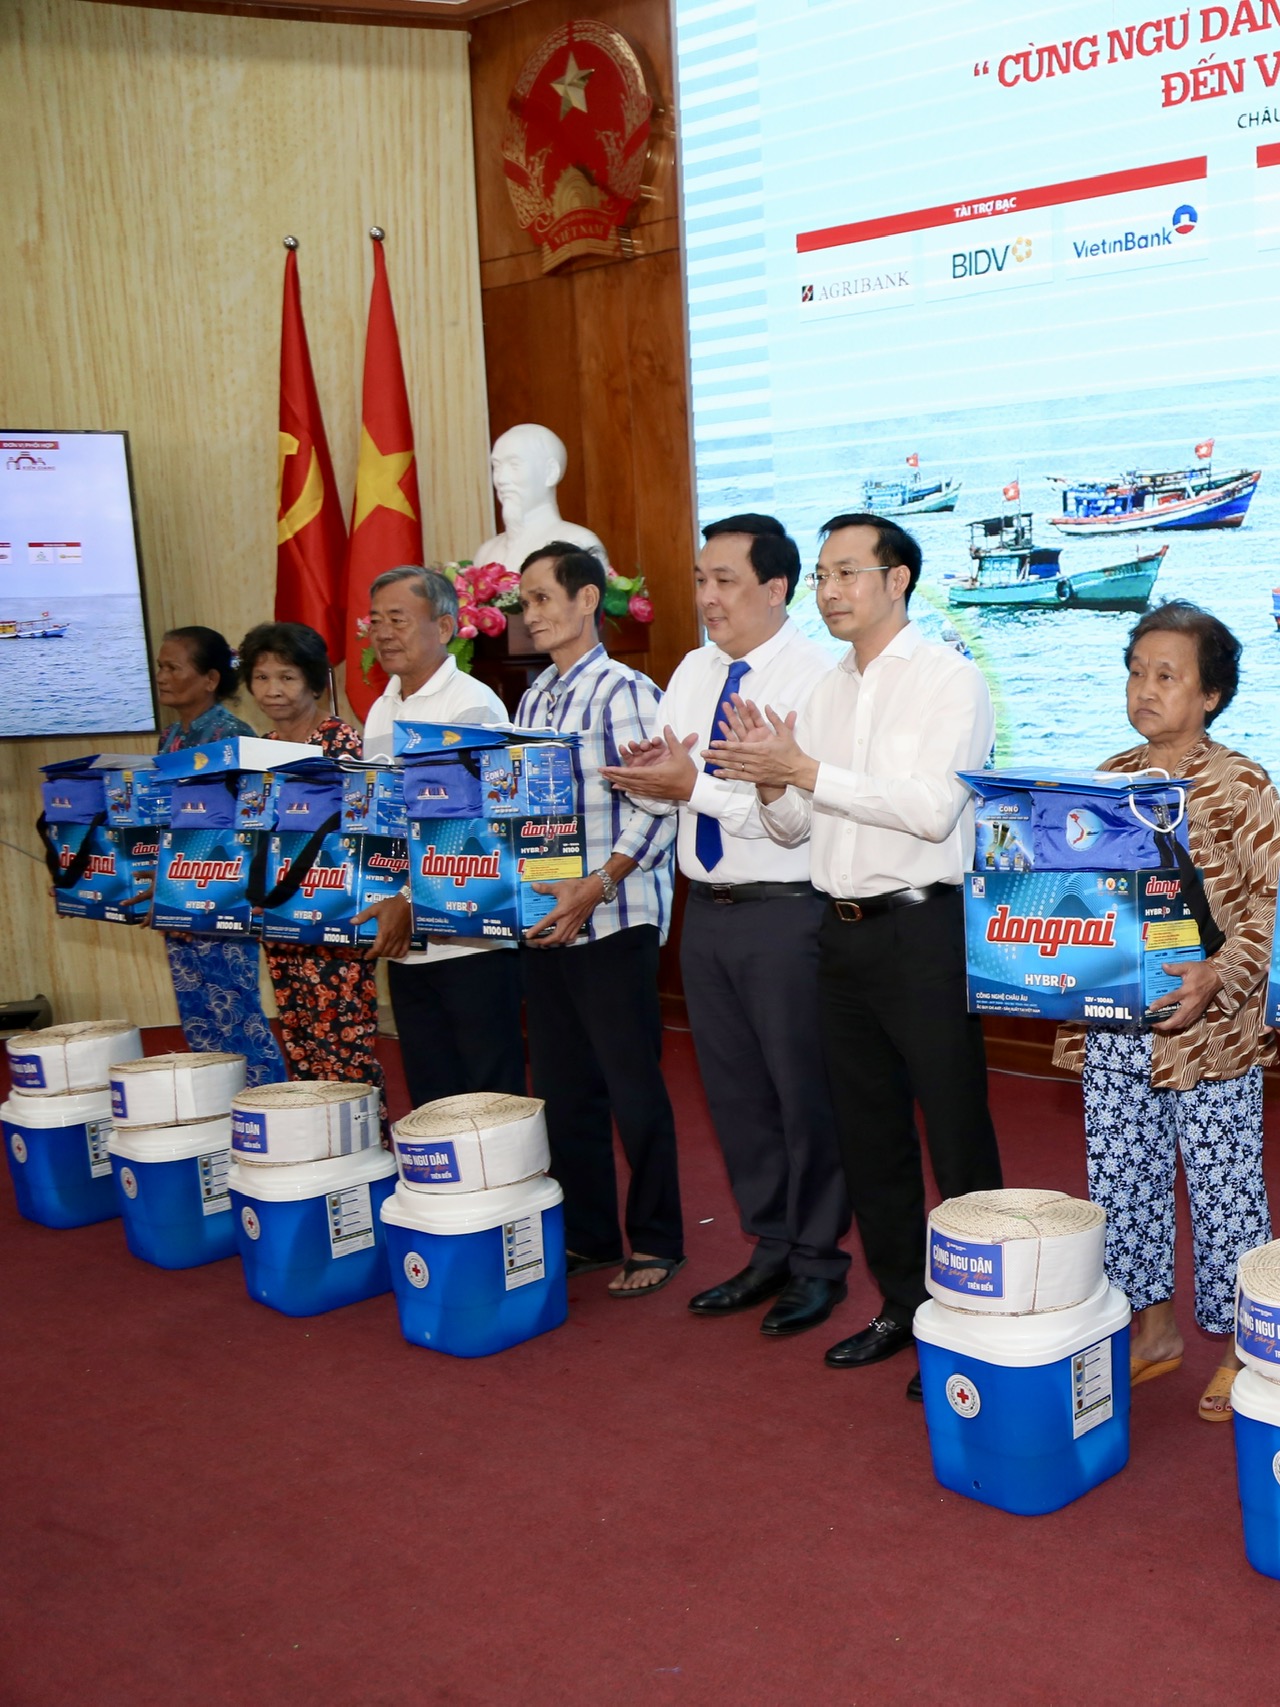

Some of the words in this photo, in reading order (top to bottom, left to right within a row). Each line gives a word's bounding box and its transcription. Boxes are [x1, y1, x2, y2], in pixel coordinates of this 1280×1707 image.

[1107, 7, 1190, 65] NGƯ
[1161, 52, 1246, 108] ĐẾN
[954, 203, 972, 218] TÀI
[972, 200, 994, 216] TRỢ
[996, 197, 1018, 214] BẠC
[1073, 226, 1172, 260] VietinBank
[952, 244, 1011, 280] BIDV
[818, 270, 911, 302] AGRIBANK
[421, 845, 501, 887] dongnai
[985, 904, 1117, 958] dongnai
[1084, 1004, 1114, 1019] N100
[933, 1244, 949, 1266] CÙNG
[950, 1253, 969, 1271] NGƯ
[970, 1256, 993, 1274] DÂN
[1255, 1319, 1276, 1338] NGƯ
